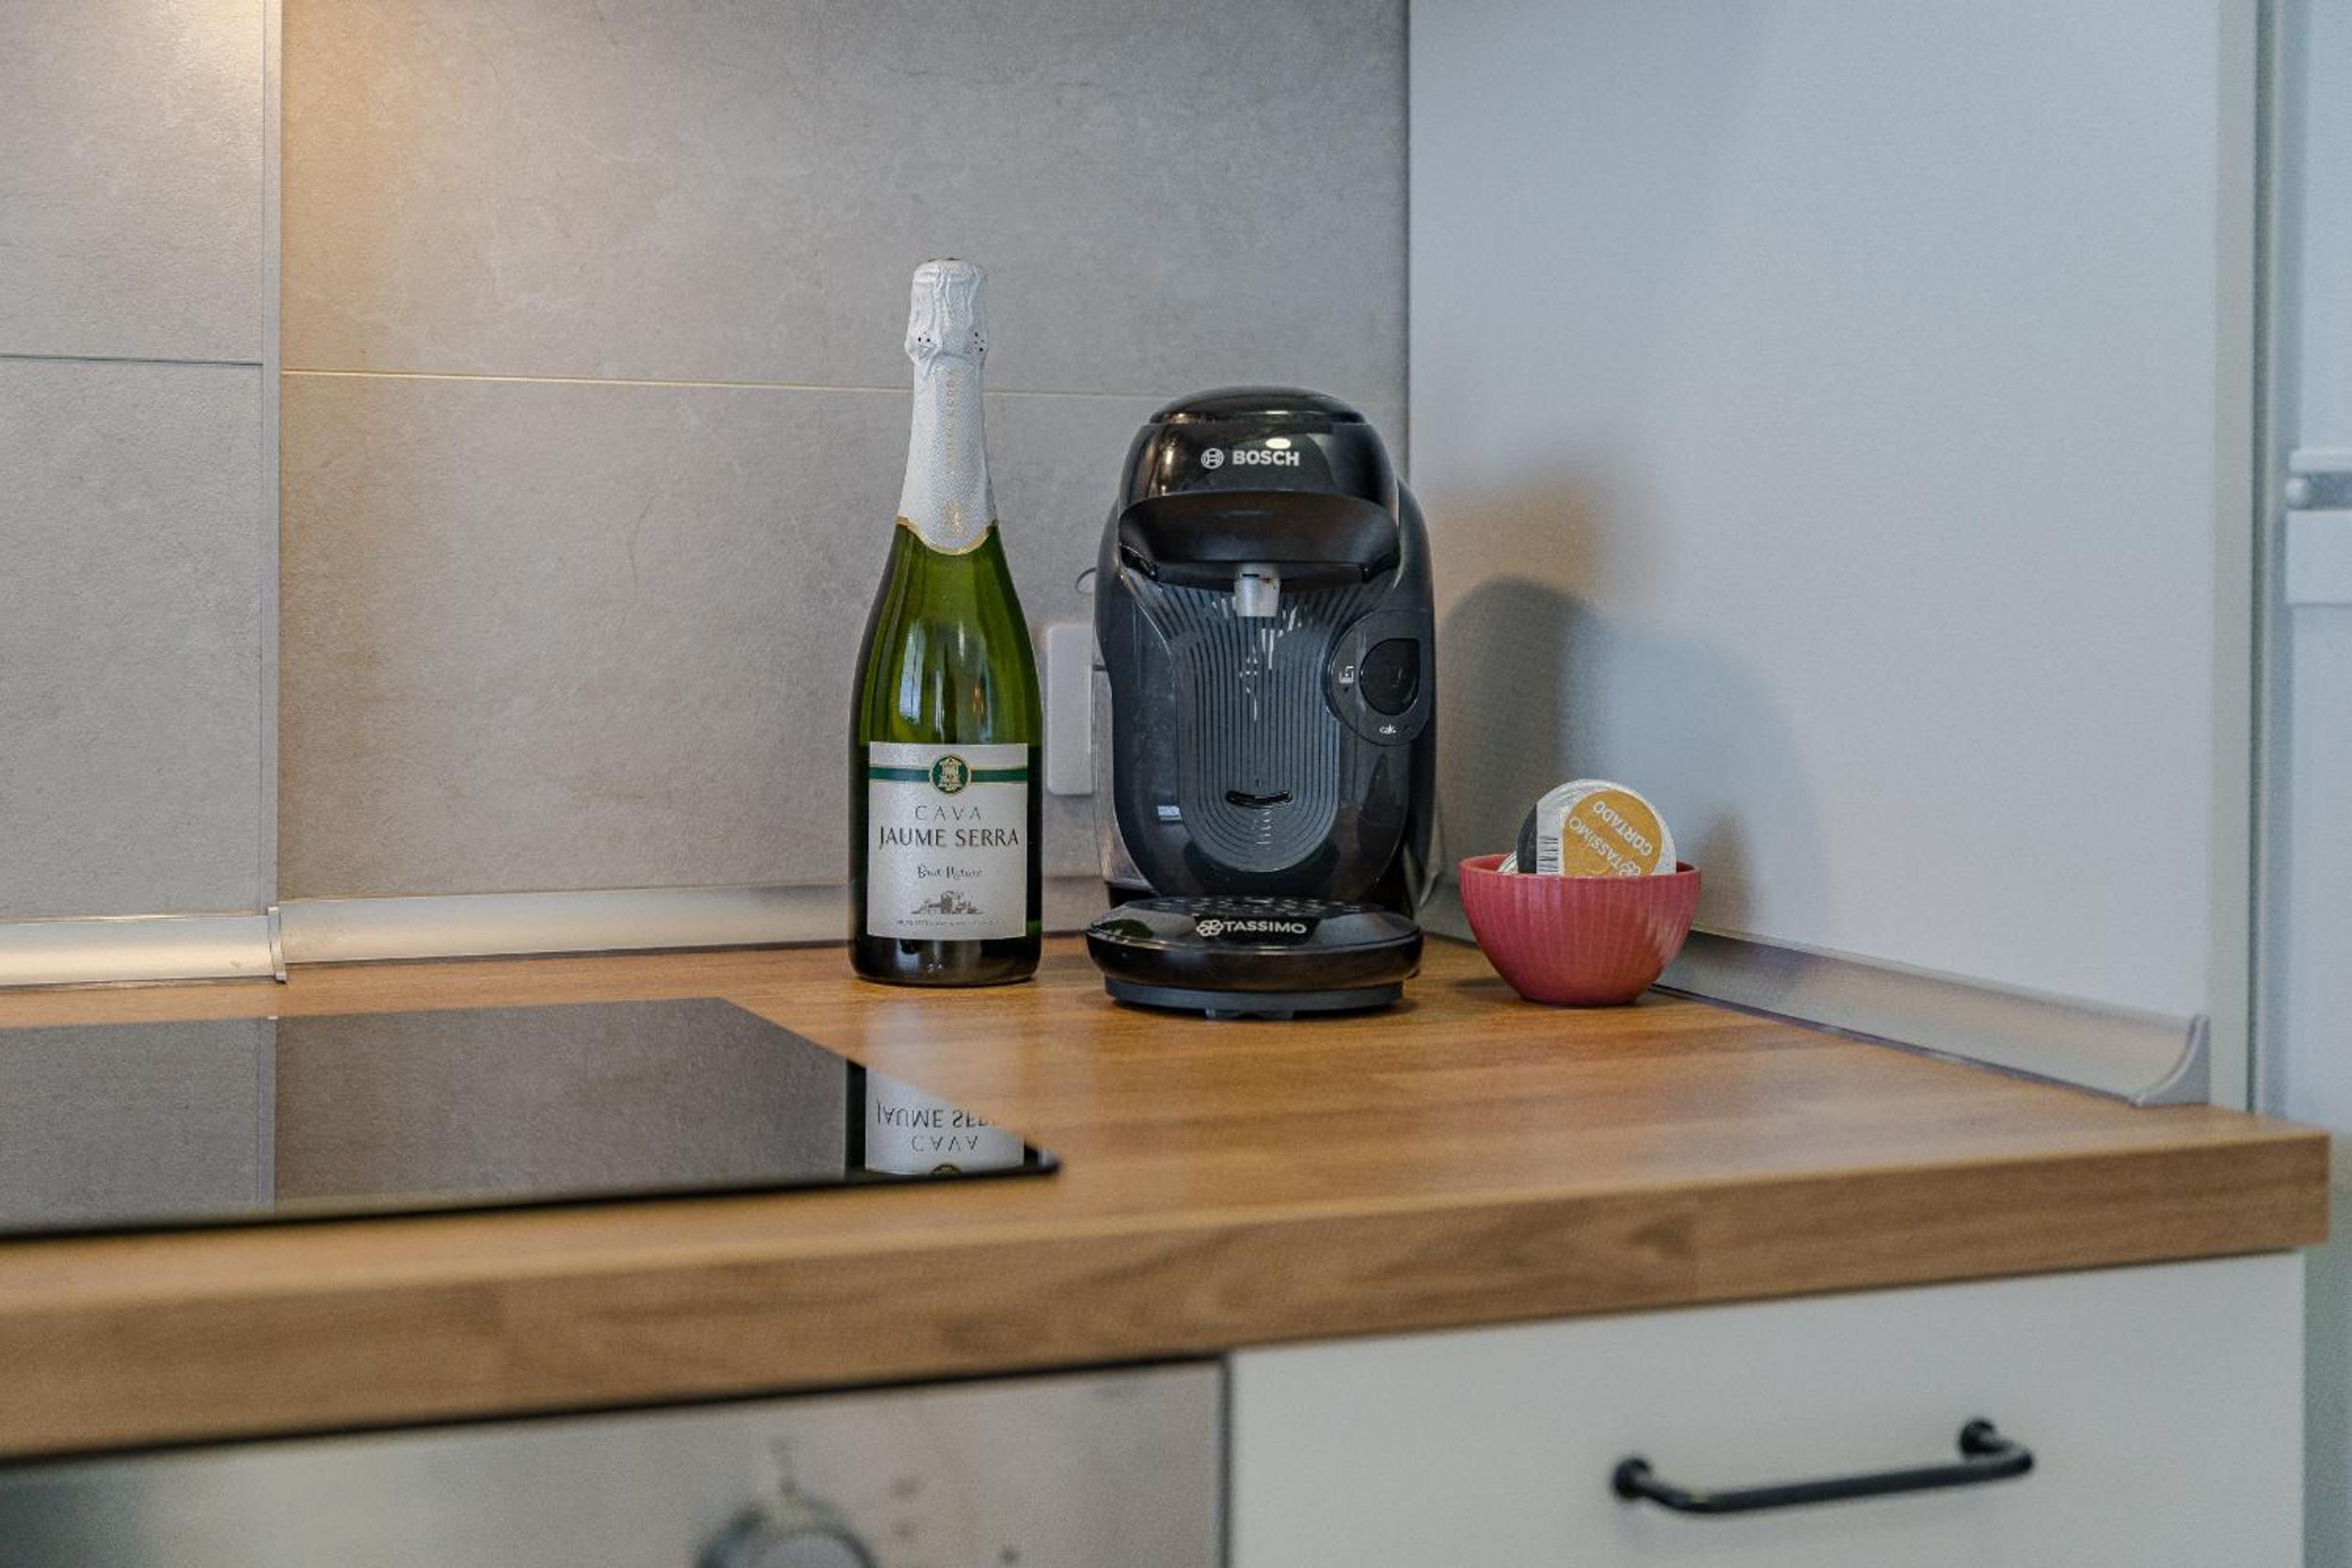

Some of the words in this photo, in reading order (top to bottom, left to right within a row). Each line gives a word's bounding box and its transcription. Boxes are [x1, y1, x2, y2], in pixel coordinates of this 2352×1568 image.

[1232, 450, 1300, 467] BOSCH
[914, 805, 982, 821] CAVA
[879, 826, 946, 850] JAUME
[955, 828, 1019, 847] SERRA
[1592, 800, 1653, 856] CORTADO
[1568, 816, 1623, 870] TASSIMO
[1223, 921, 1308, 934] TASSIMO
